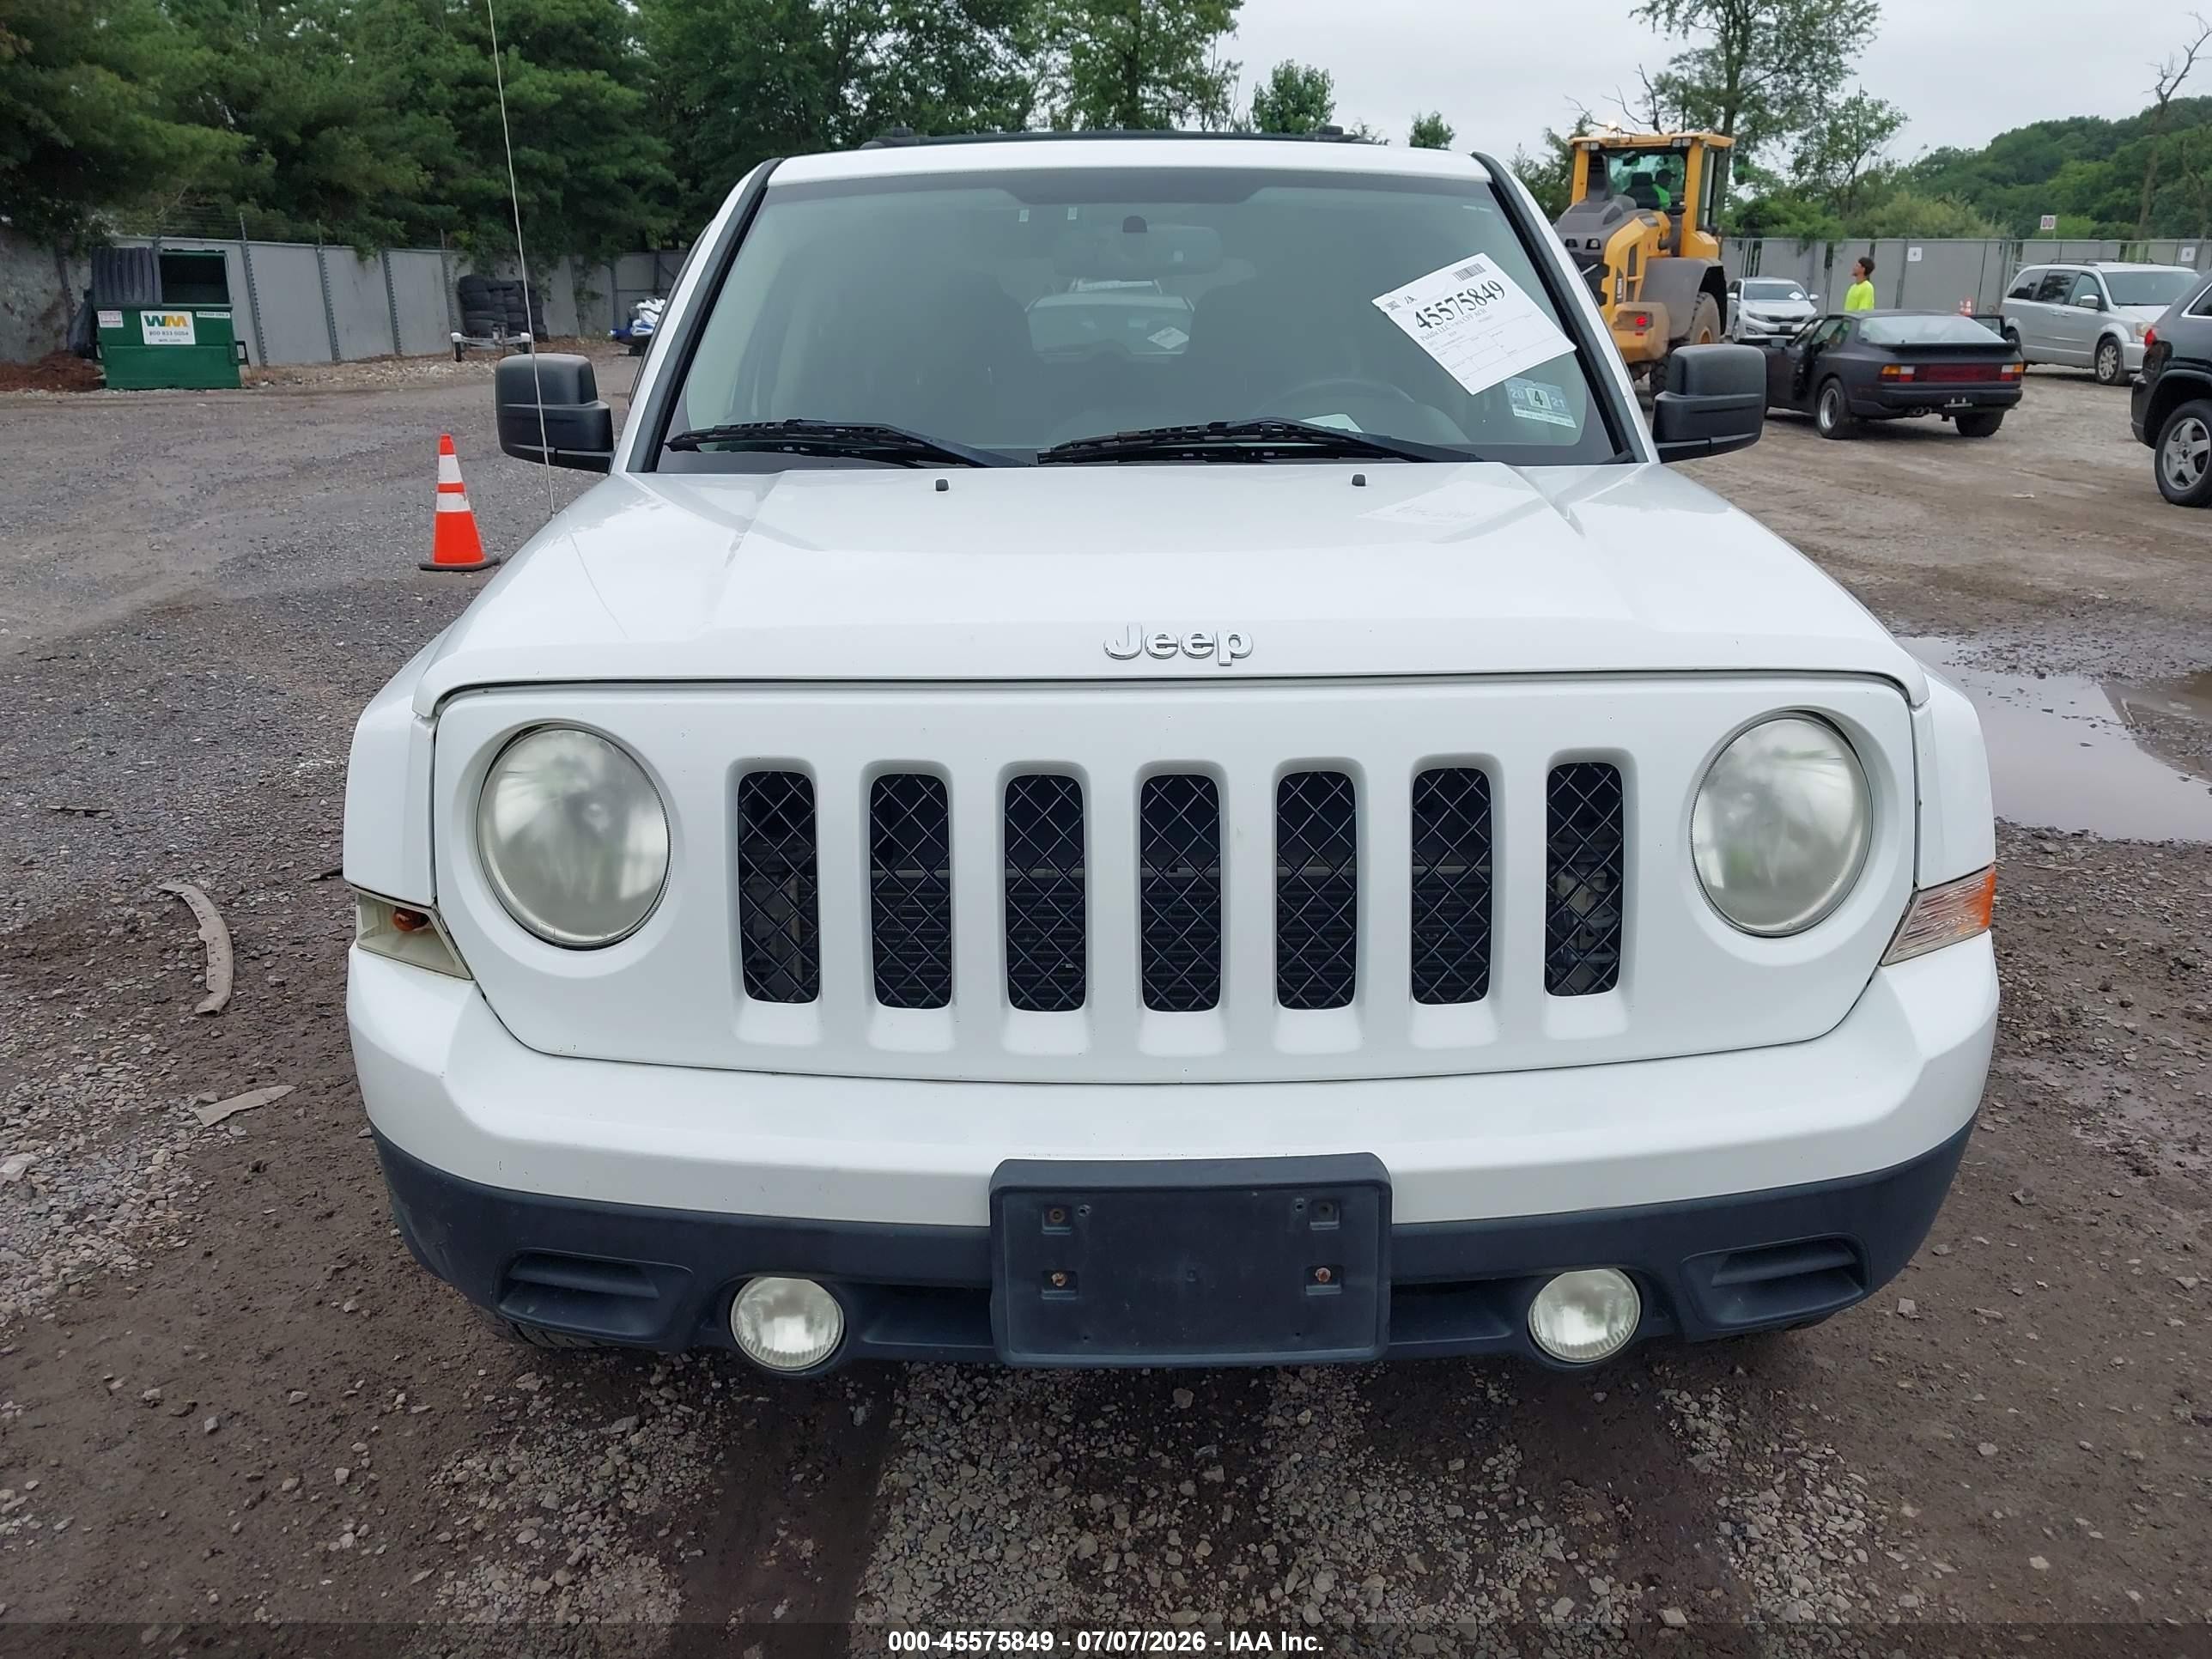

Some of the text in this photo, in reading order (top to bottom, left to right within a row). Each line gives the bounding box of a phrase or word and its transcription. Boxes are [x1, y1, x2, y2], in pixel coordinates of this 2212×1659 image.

[1415, 280, 1505, 329] 45575849
[144, 315, 188, 326] WM
[1510, 388, 1525, 399] 20
[1534, 391, 1543, 405] 4
[1103, 623, 1254, 666] Jeep
